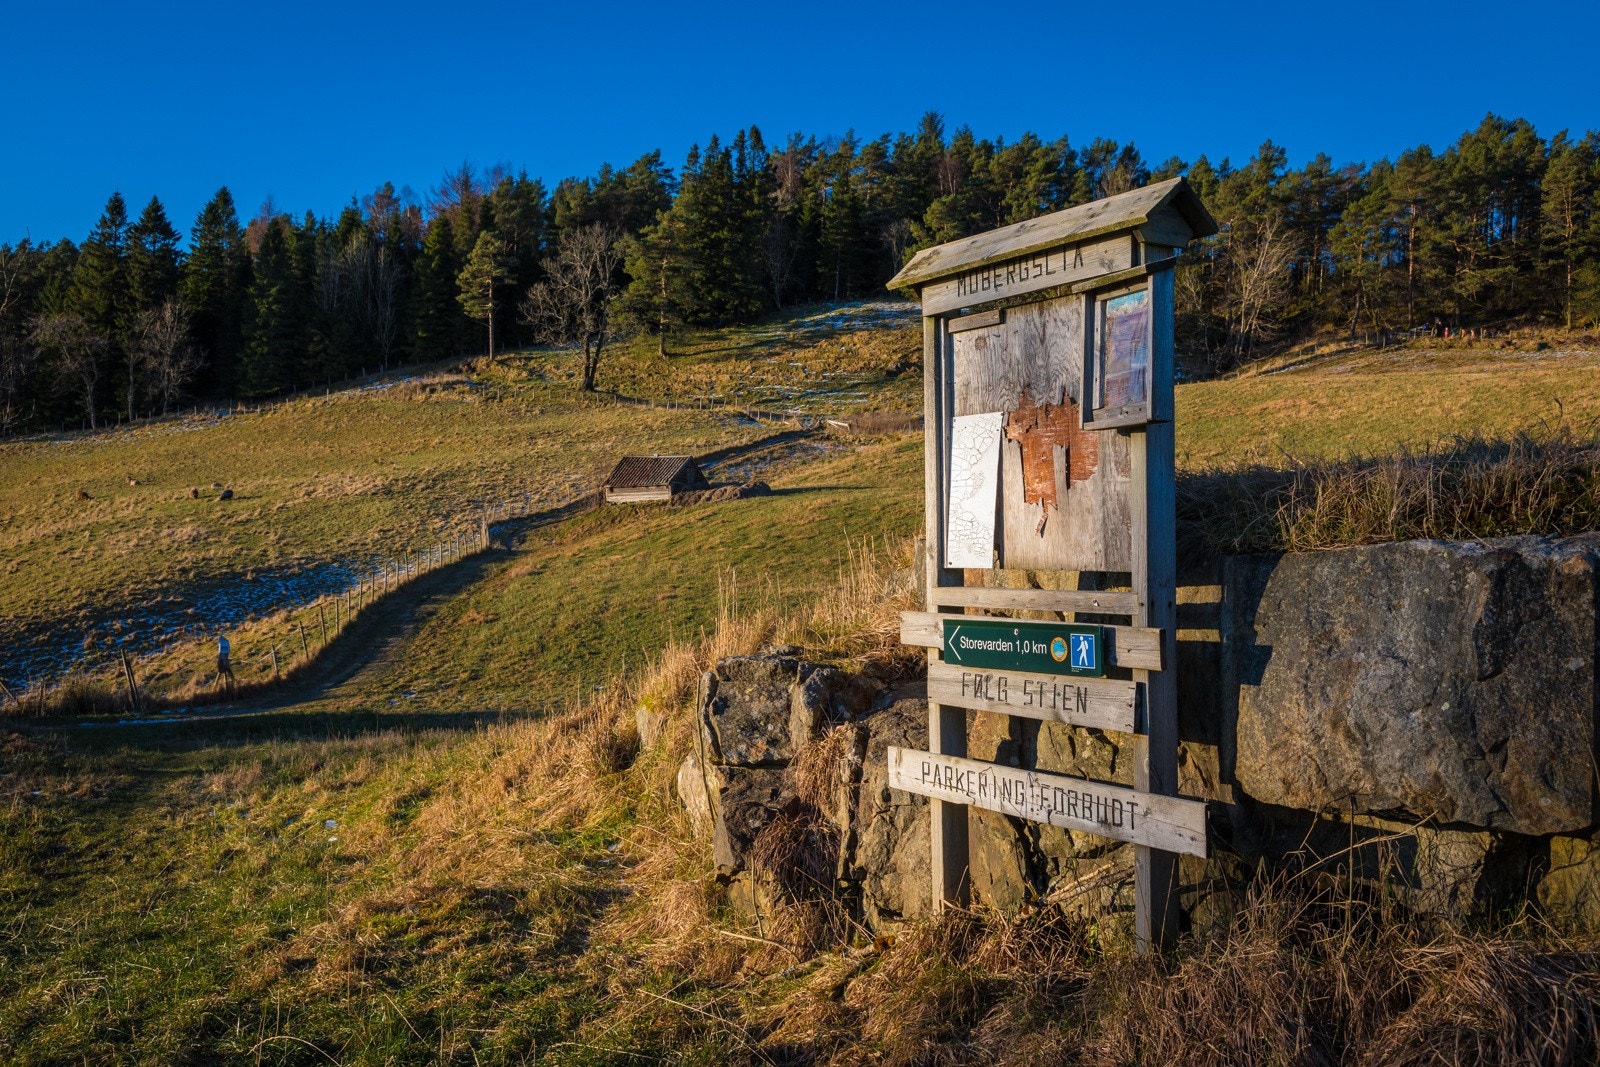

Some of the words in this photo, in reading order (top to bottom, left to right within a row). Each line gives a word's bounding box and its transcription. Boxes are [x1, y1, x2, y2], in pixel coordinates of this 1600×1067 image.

[958, 245, 1083, 297] MOBERGSLIA
[960, 637, 1013, 652] Storevarden
[1016, 642, 1030, 655] 1,0
[1032, 643, 1047, 654] km
[961, 672, 1008, 702] FØLG
[1023, 680, 1088, 714] STIEN
[921, 761, 1025, 805] PARKERING
[1039, 784, 1139, 830] FORBUDT
